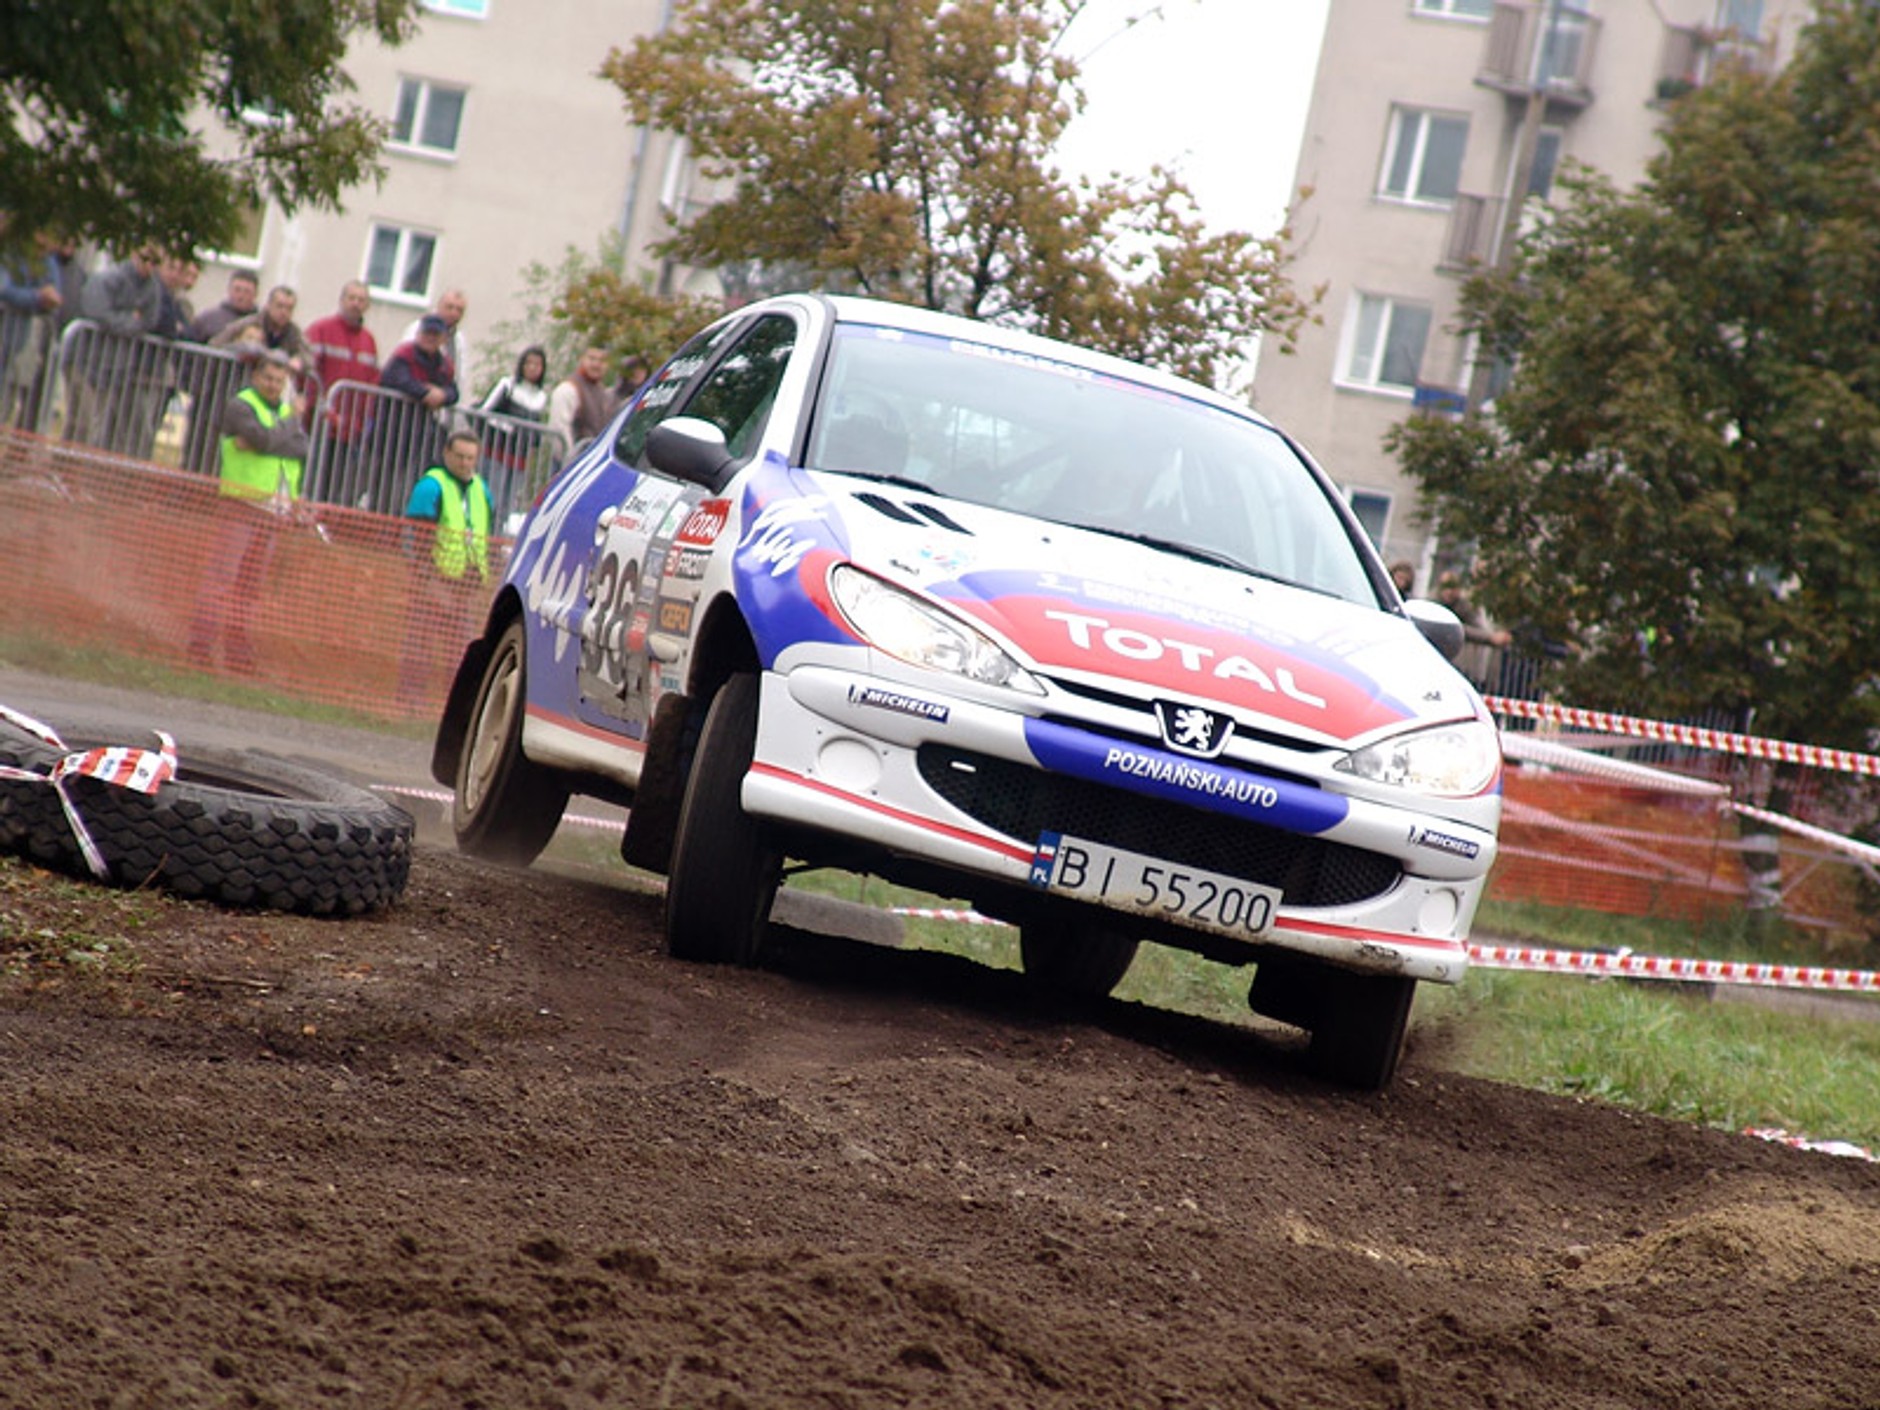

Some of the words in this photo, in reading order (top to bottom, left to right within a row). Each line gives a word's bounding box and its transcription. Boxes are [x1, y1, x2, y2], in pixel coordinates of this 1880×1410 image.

[682, 506, 726, 538] TOTAL
[581, 552, 638, 684] 36
[1043, 609, 1327, 709] TOTAL
[866, 690, 947, 718] MICHELIN
[1104, 747, 1278, 808] POZNAŃSKI-AUTO
[1032, 866, 1048, 883] PL
[1135, 865, 1271, 934] 55200
